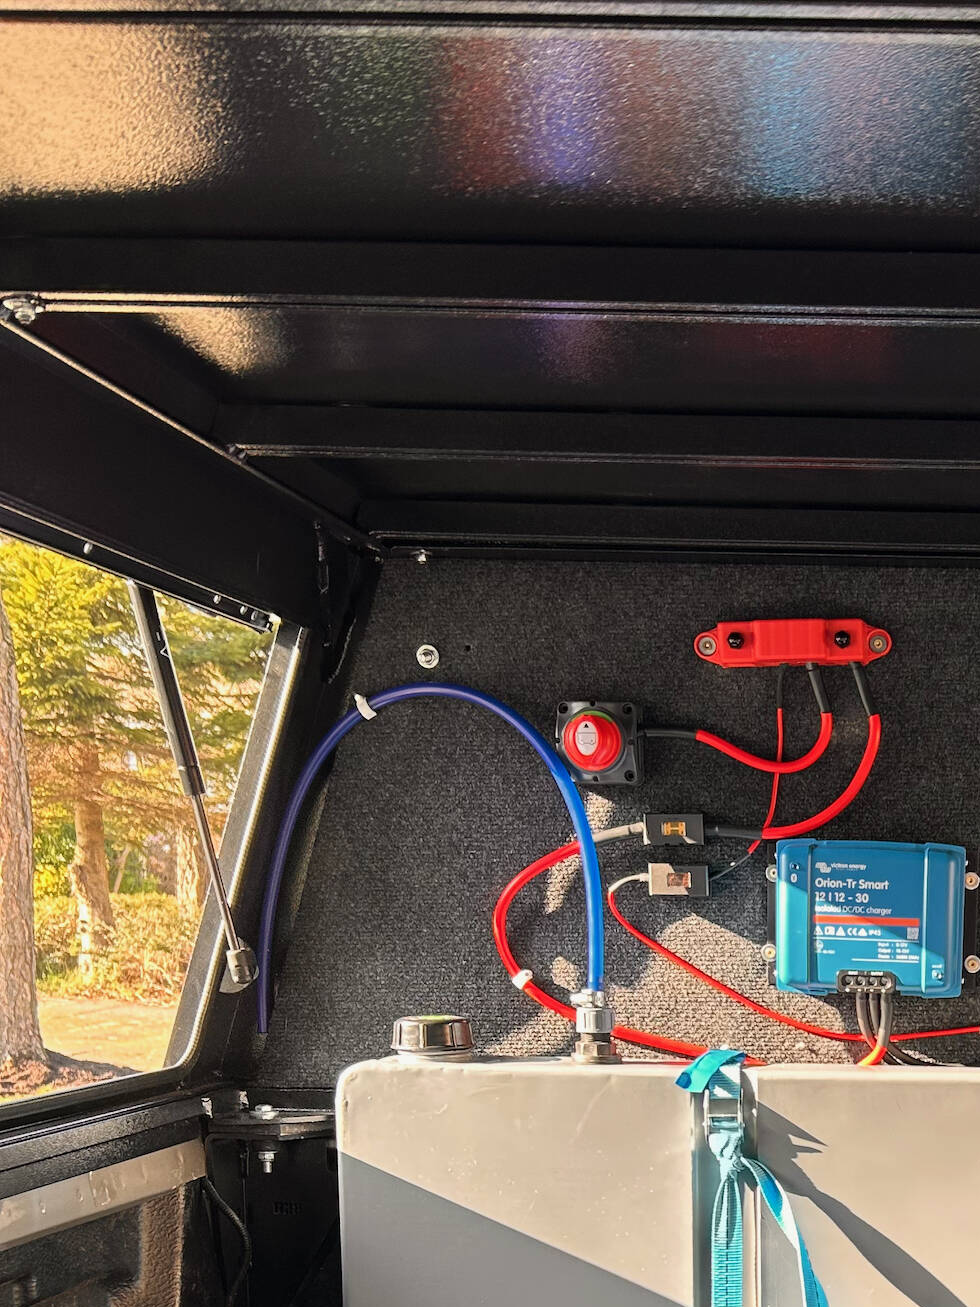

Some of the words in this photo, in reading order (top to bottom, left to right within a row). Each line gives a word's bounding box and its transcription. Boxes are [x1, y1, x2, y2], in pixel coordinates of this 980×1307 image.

[815, 877, 857, 888] Orion-Tr
[858, 879, 889, 890] Smart
[842, 905, 865, 913] DC/DC
[866, 906, 892, 916] charger
